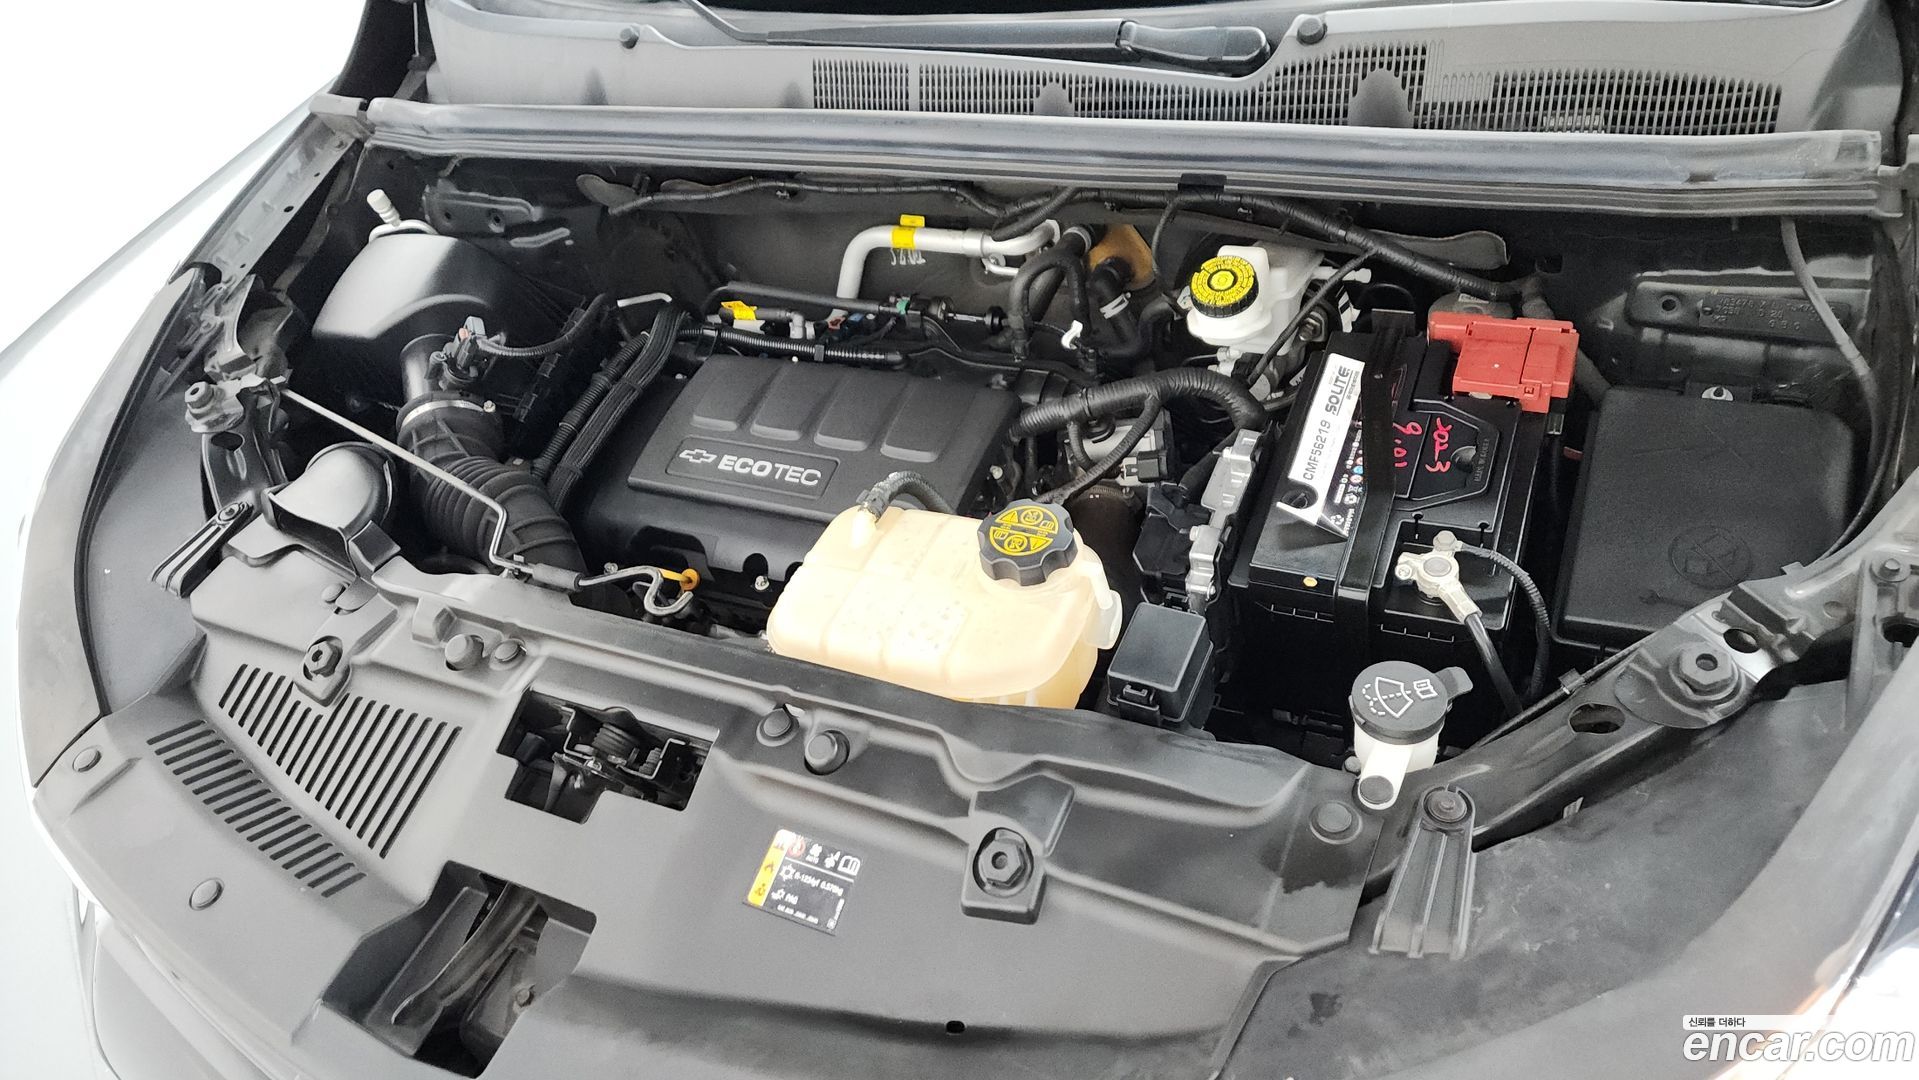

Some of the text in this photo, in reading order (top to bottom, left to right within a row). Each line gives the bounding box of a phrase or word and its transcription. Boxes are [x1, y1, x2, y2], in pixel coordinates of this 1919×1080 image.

[1325, 365, 1351, 416] SOLITE
[718, 454, 821, 486] ECOTEC
[1303, 419, 1332, 481] CMF56219
